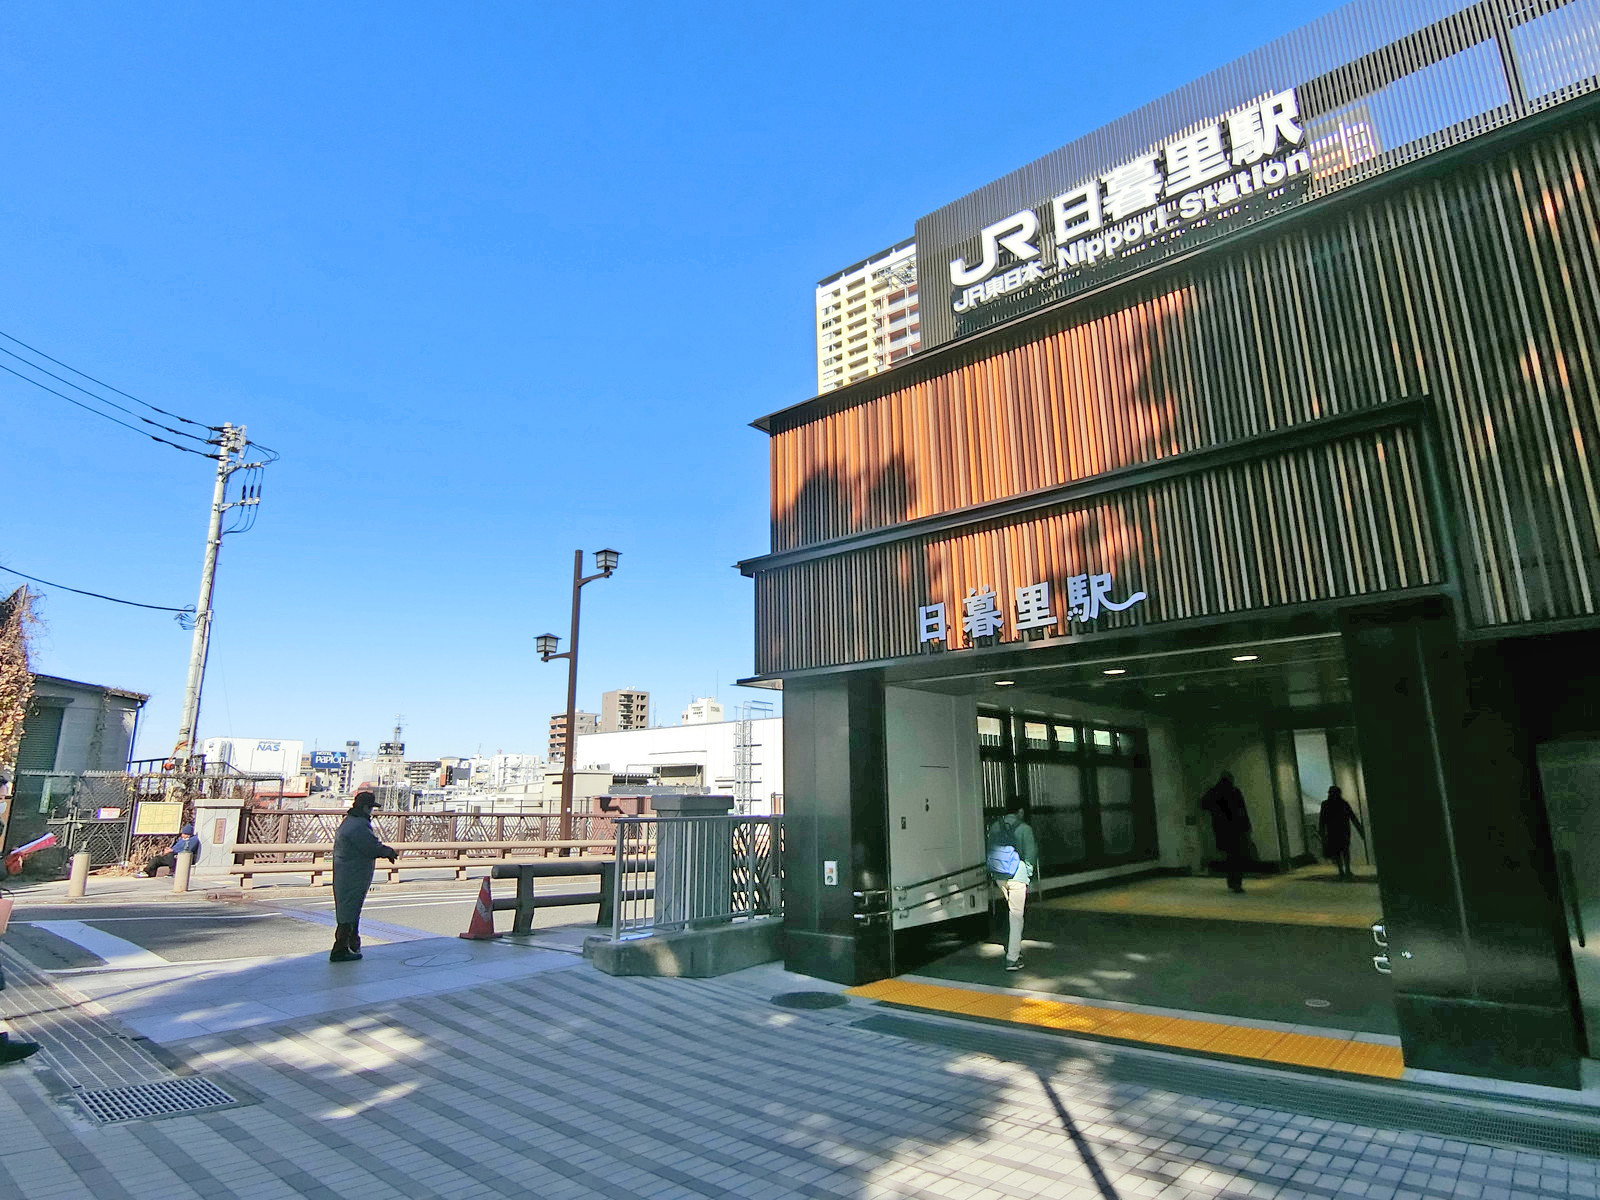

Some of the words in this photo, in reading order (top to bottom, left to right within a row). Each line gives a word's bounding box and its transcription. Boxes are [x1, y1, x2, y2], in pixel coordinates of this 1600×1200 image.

[1057, 201, 1167, 270] Nippori
[1179, 151, 1310, 219] Station
[953, 261, 1045, 312] JR東日本
[919, 572, 1147, 642] 日暮里駅
[257, 744, 280, 752] NAS
